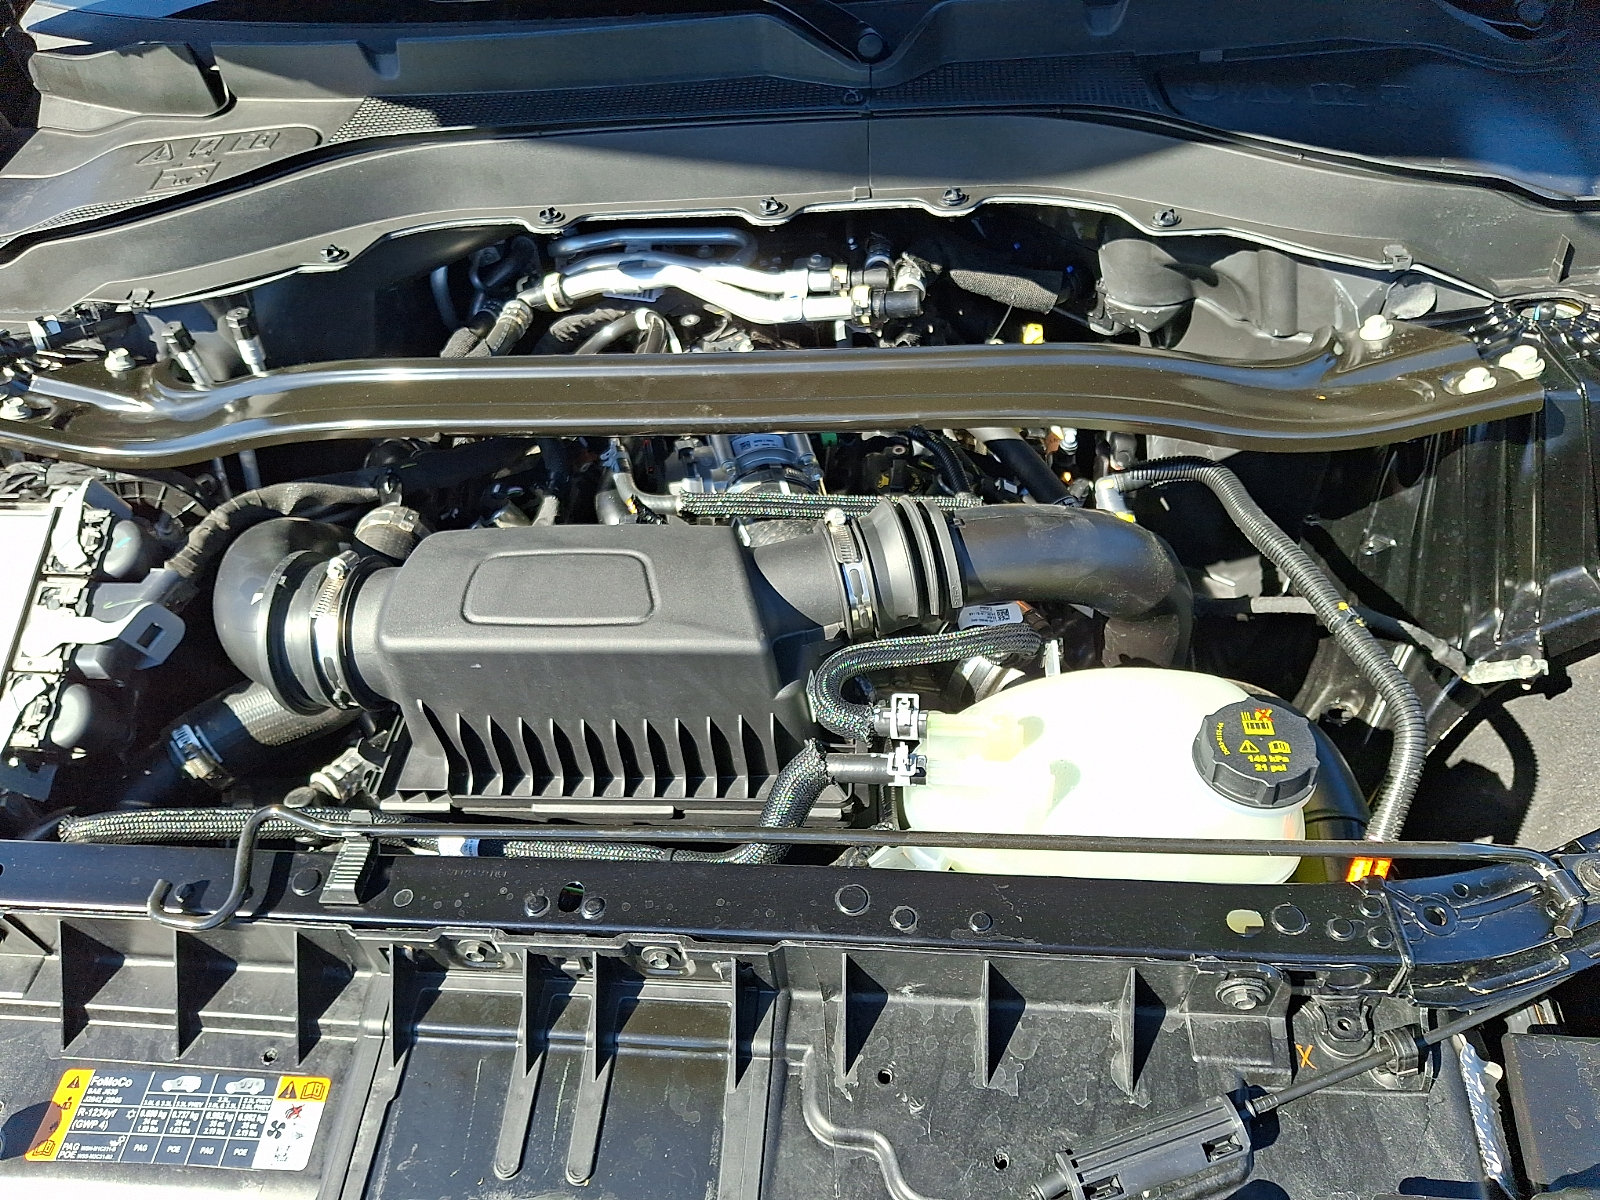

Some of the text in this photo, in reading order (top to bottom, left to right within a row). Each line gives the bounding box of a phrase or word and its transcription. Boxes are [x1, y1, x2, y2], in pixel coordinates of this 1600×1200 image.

[1268, 755, 1290, 763] kPa
[1254, 763, 1288, 773] 21 psi
[89, 1075, 133, 1088] FoMoCo
[77, 1107, 118, 1119] R-1234yf
[71, 1119, 109, 1131] (GWP 4)
[61, 1142, 80, 1151] PAG
[133, 1143, 148, 1152] PAG
[167, 1145, 182, 1153] POE
[199, 1146, 215, 1155] PAG
[58, 1150, 77, 1159] POE
[233, 1147, 249, 1156] POE
